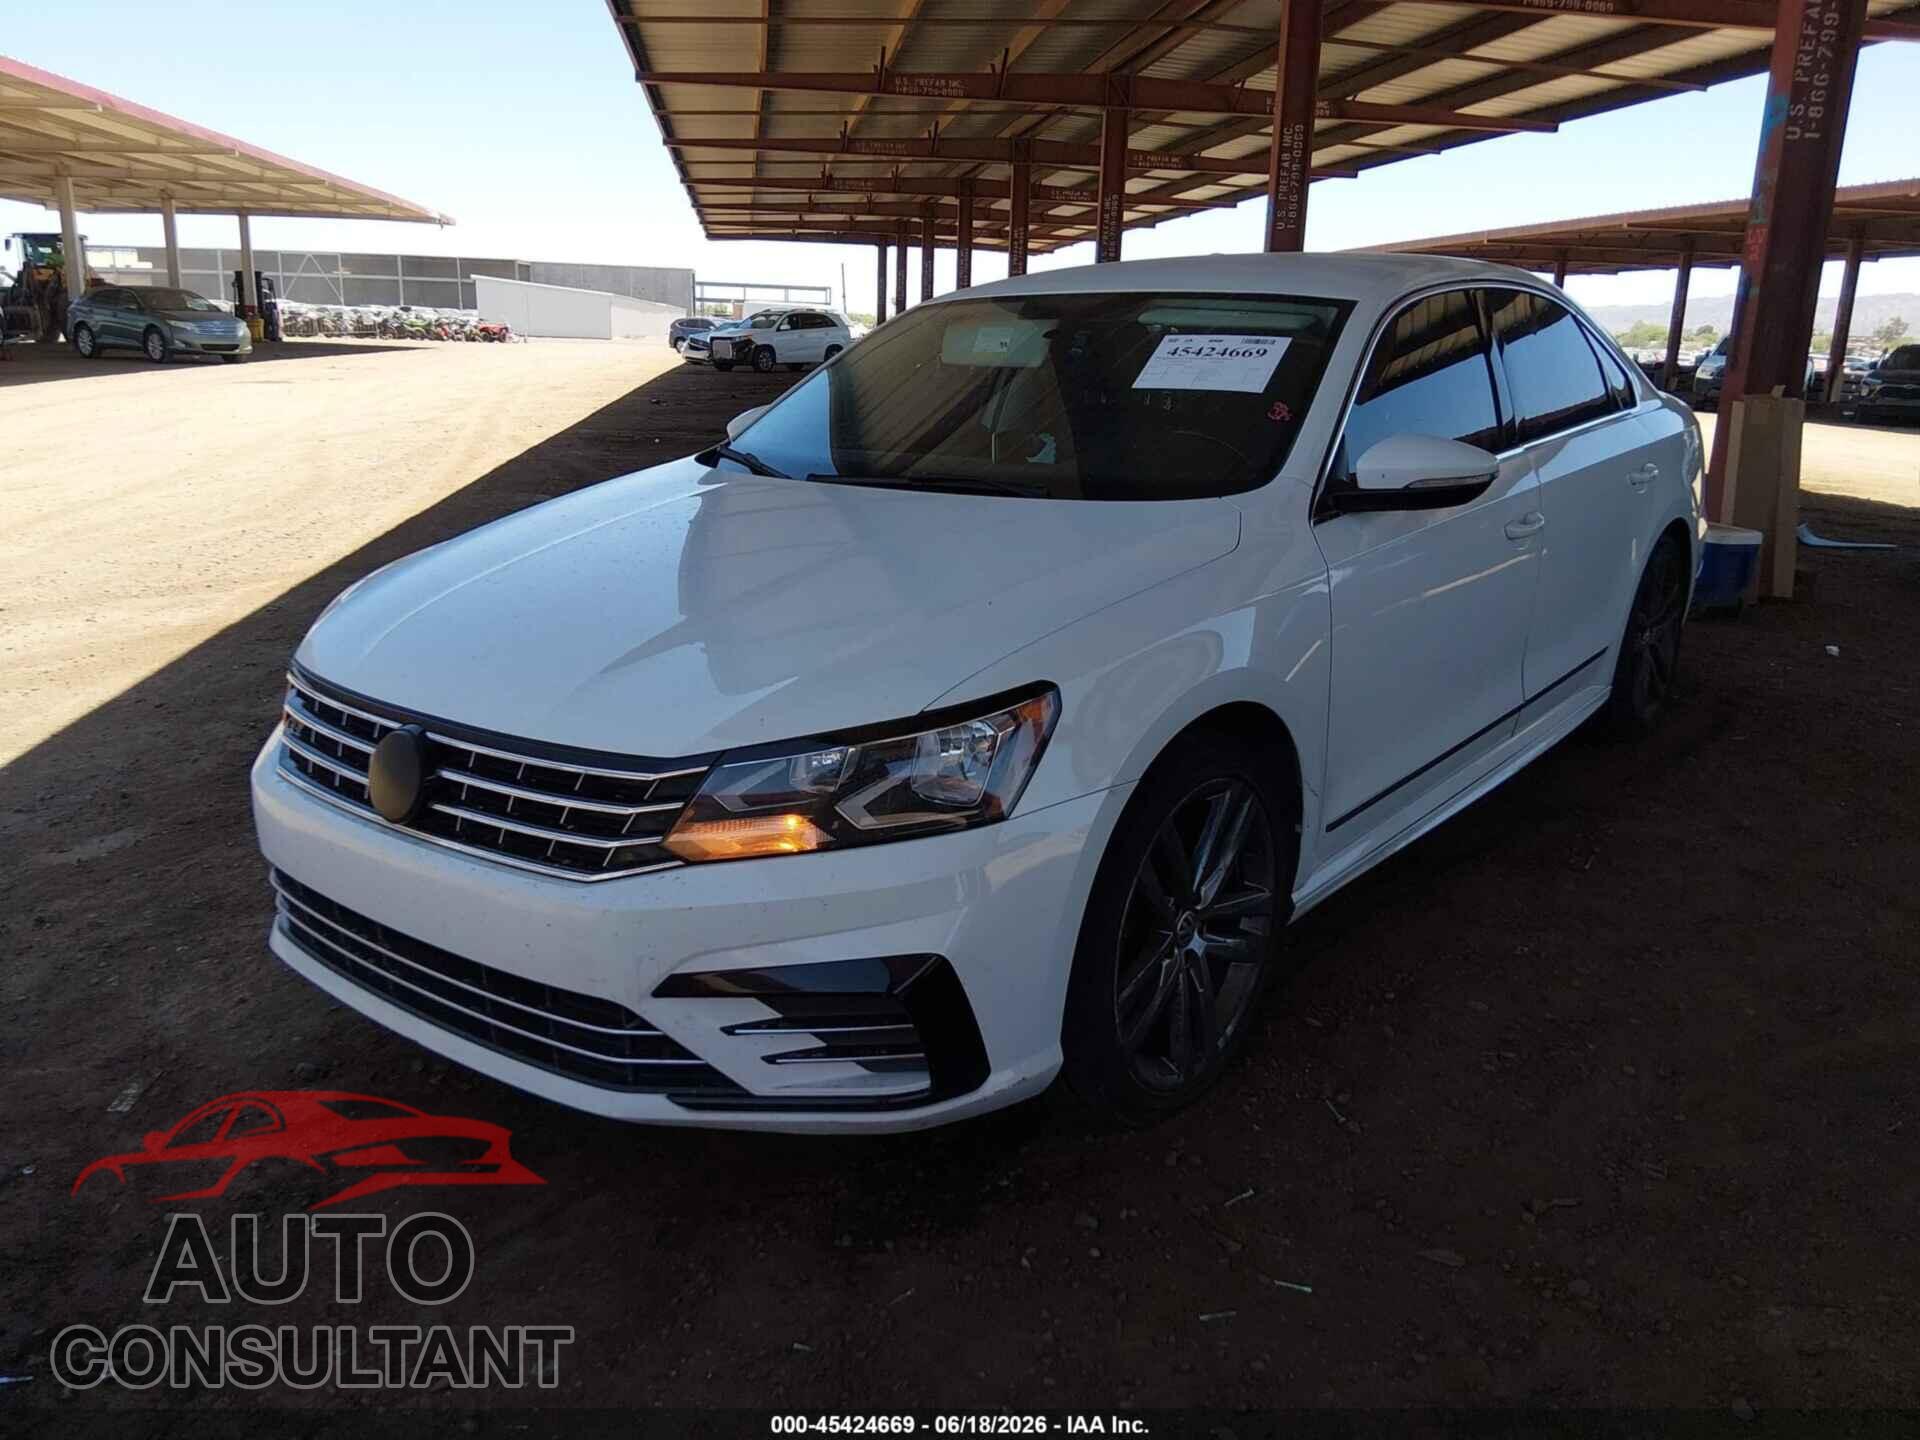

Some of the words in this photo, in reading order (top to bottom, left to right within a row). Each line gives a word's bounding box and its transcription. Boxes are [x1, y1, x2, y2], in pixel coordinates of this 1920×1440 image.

[1785, 96, 1807, 140] U.S.
[1278, 153, 1292, 200] PREFAB
[1167, 346, 1268, 358] 45424669
